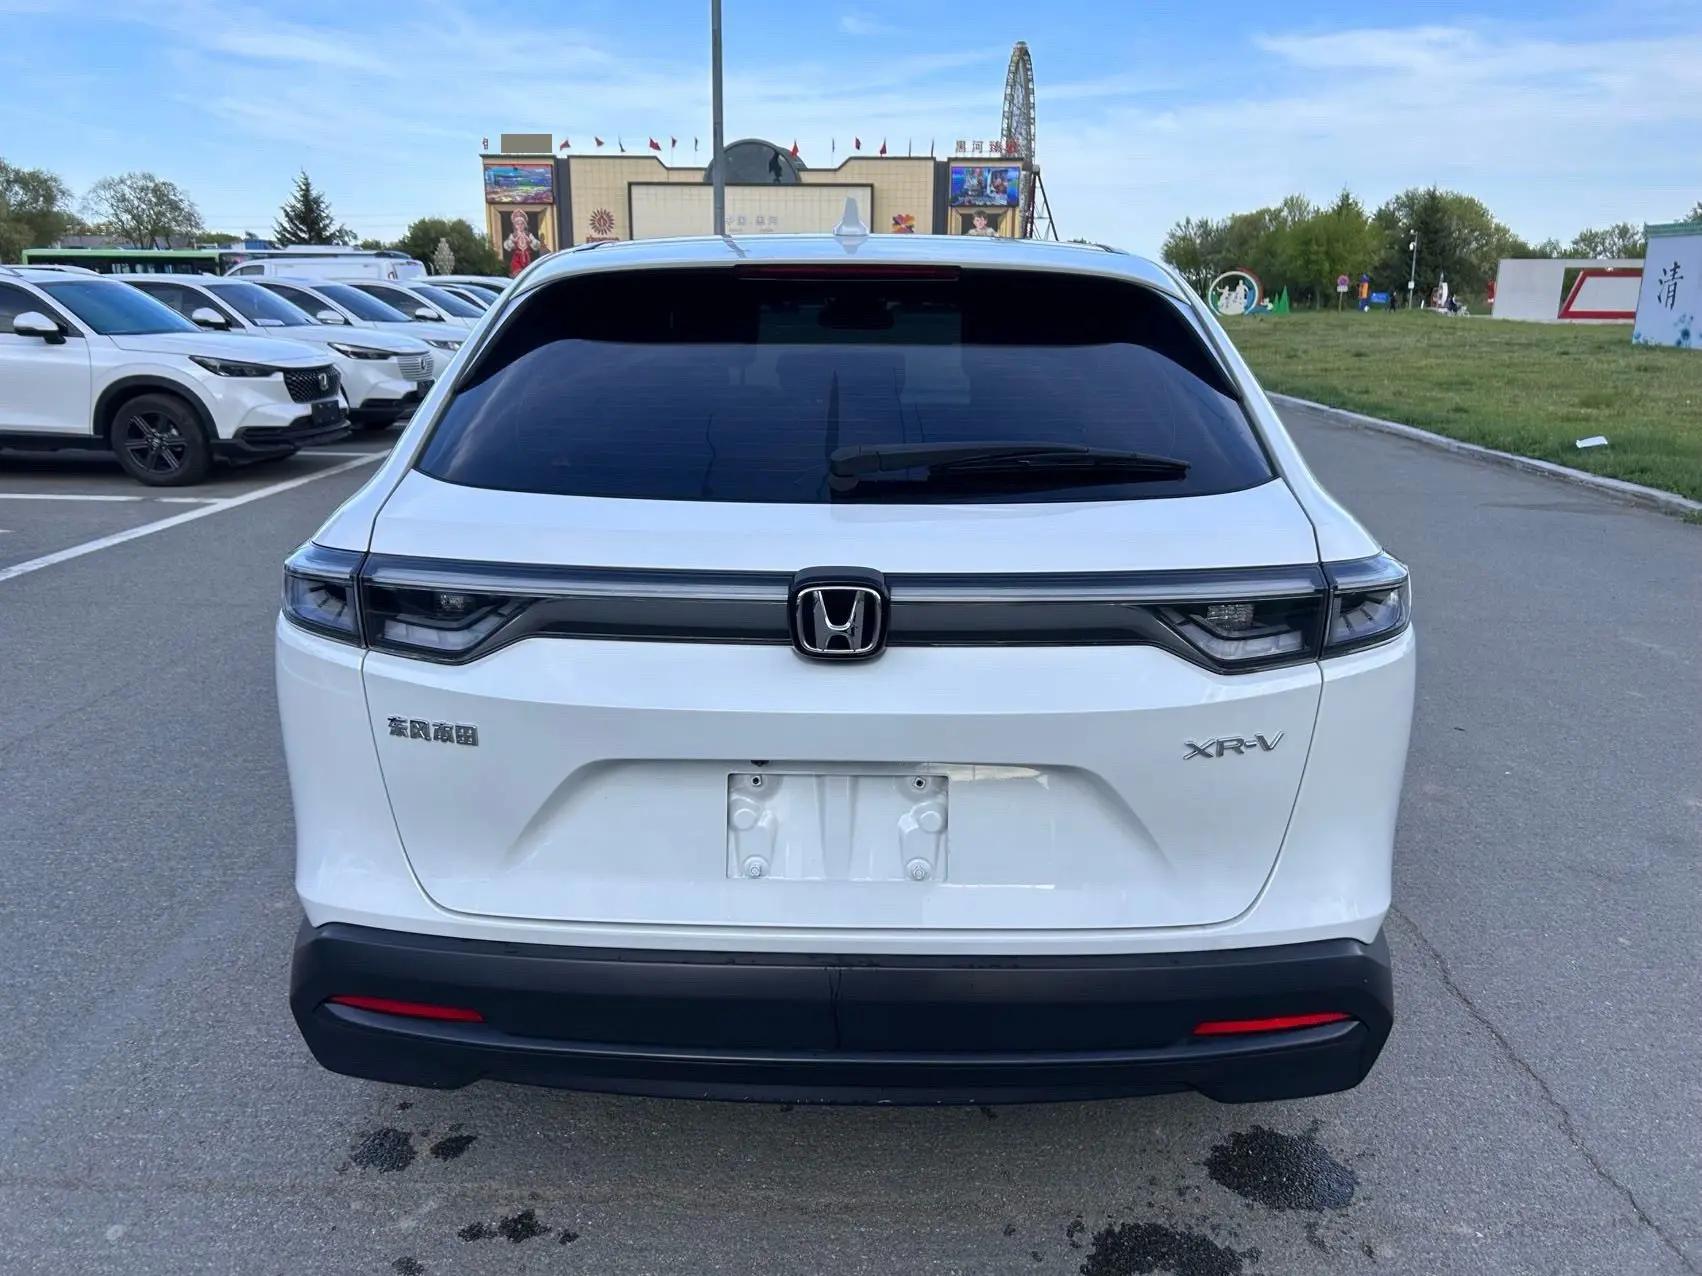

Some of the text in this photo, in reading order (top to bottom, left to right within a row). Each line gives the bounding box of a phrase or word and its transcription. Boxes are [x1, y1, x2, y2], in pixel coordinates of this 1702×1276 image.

[1657, 261, 1684, 310] 清
[386, 715, 479, 746] 东风本田
[1183, 730, 1285, 760] XR-V
